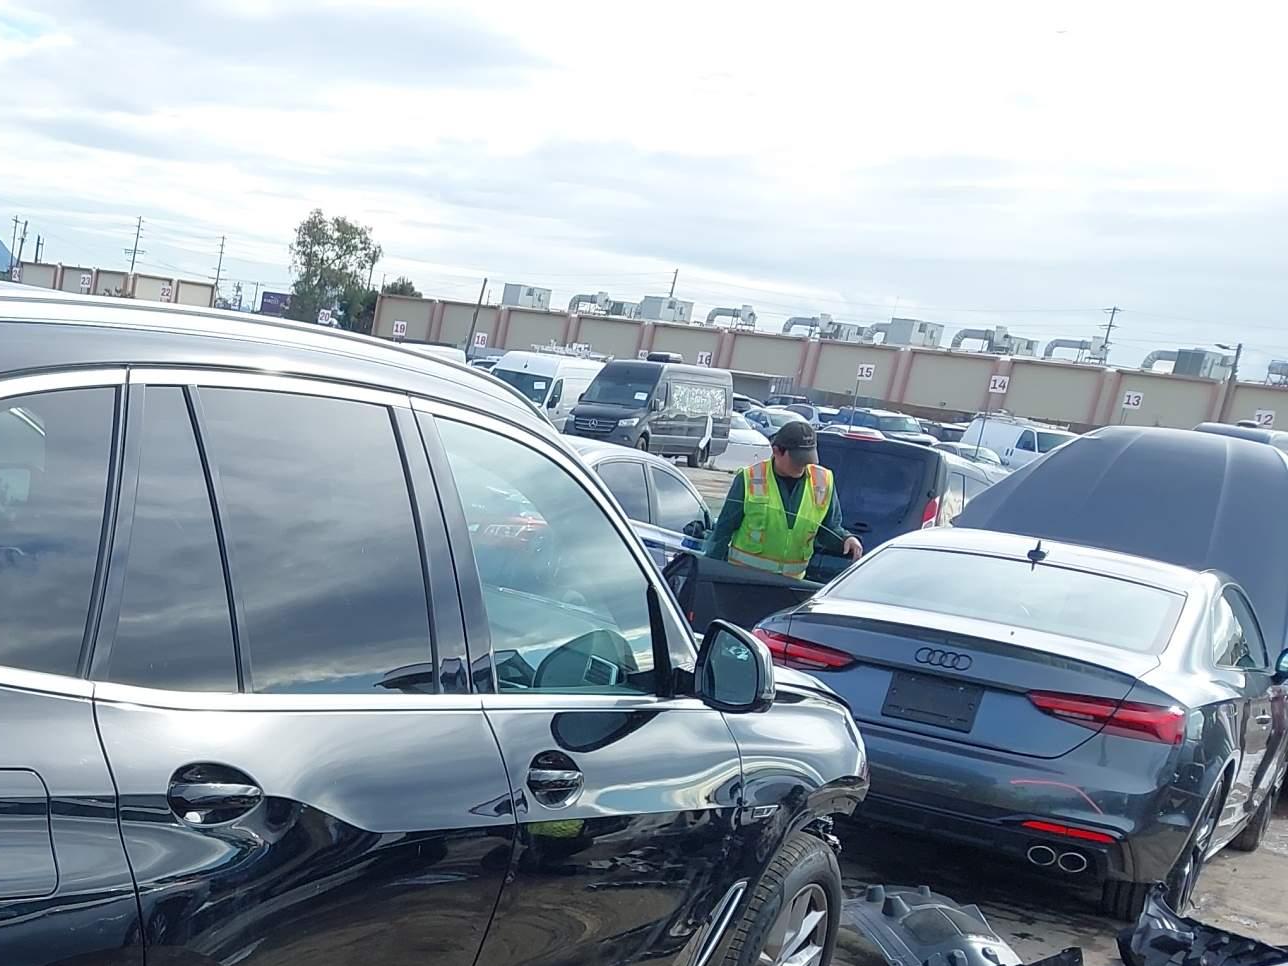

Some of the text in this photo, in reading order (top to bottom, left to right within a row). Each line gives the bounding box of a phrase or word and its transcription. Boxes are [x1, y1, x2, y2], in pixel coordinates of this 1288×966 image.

[81, 277, 91, 285] 23
[161, 288, 171, 297] 22
[319, 312, 330, 322] 20
[394, 323, 405, 333] 19
[475, 335, 486, 345] 18
[698, 355, 711, 365] 16
[858, 367, 873, 378] 15
[991, 379, 1007, 390] 14
[1124, 394, 1141, 407] 13
[1256, 413, 1273, 426] 12
